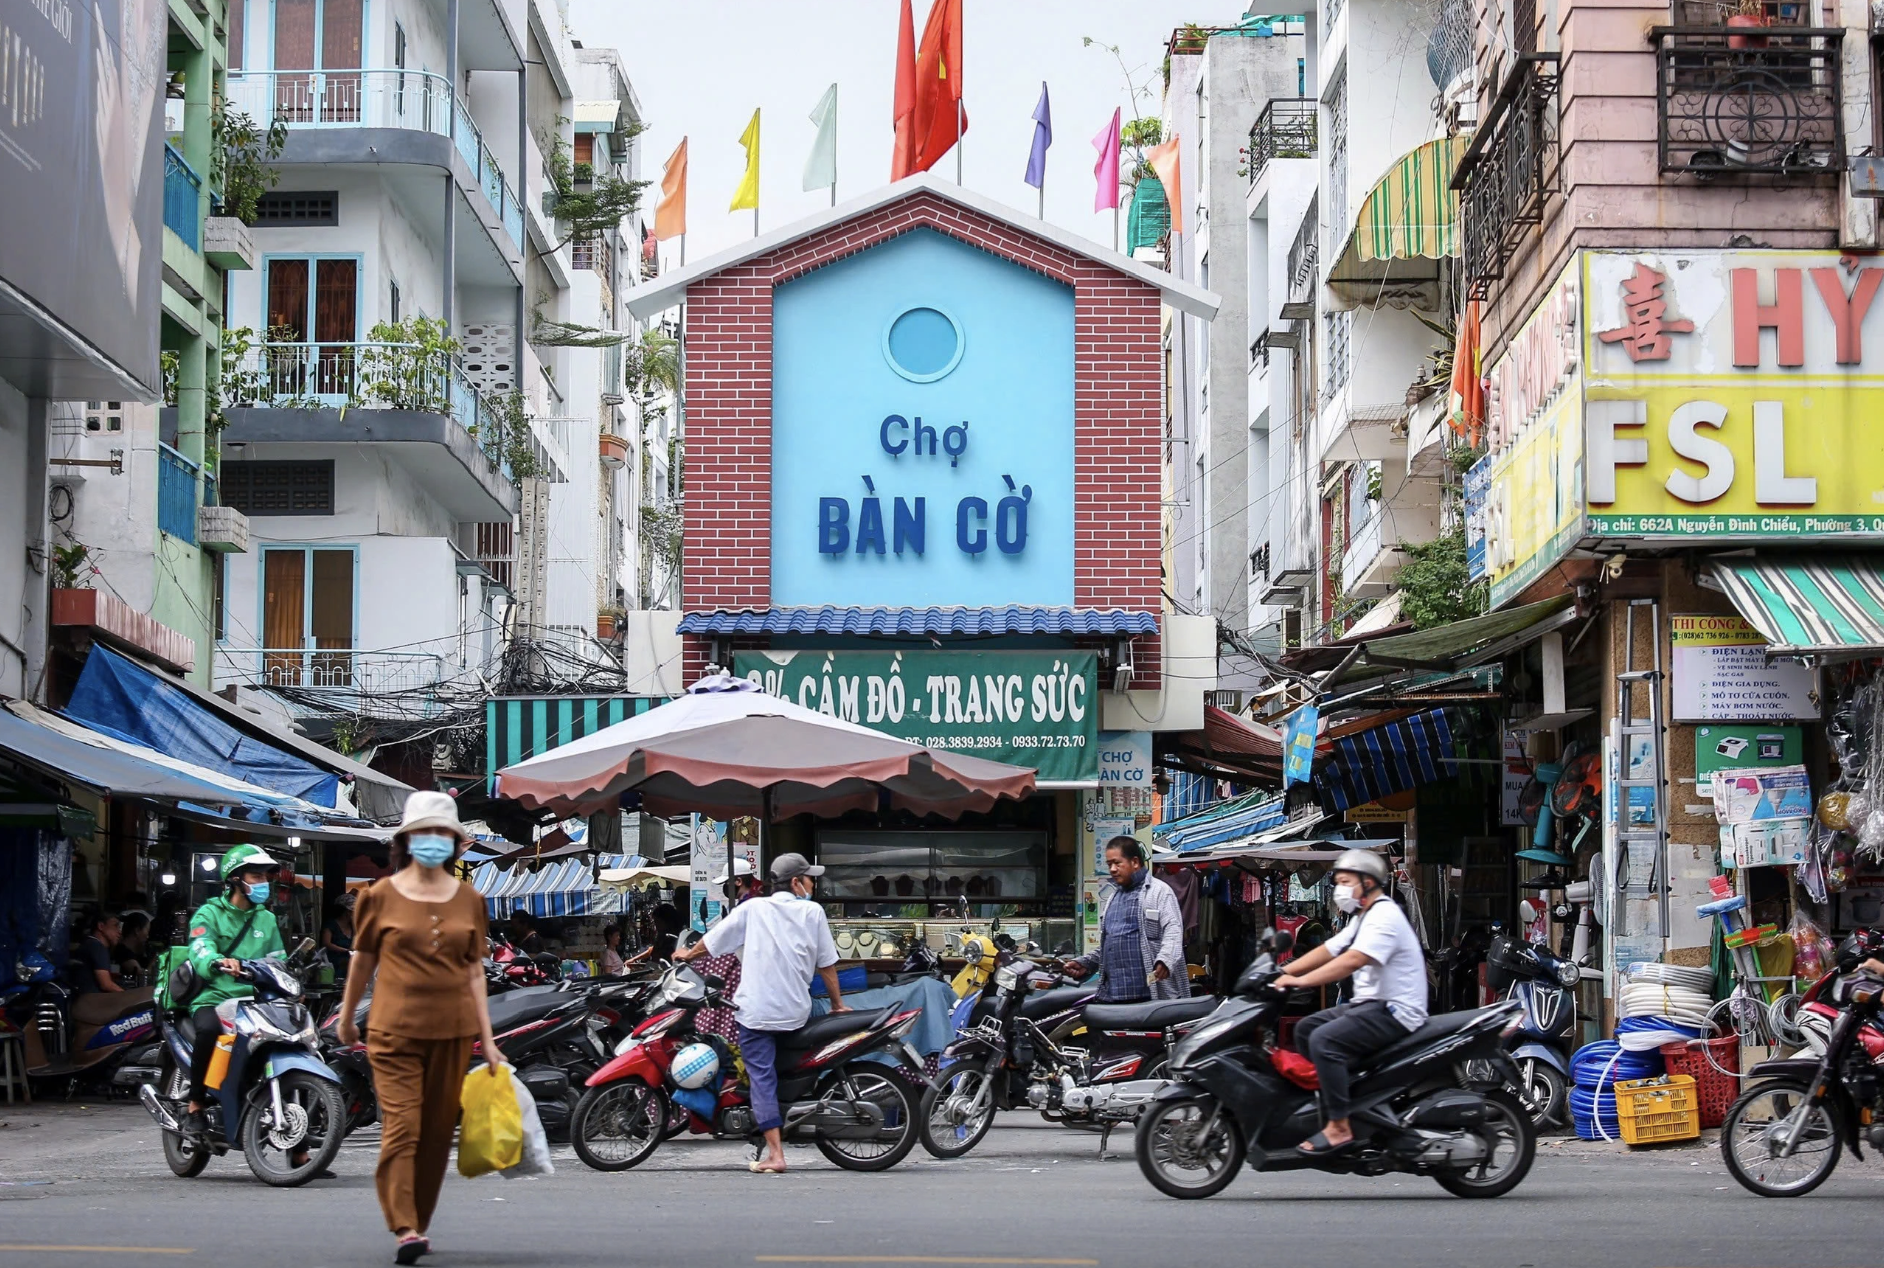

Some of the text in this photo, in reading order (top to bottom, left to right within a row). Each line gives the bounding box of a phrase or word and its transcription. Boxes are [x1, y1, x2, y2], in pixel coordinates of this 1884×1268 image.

[1599, 262, 1695, 363] 喜
[880, 414, 969, 468] Chợ
[1587, 400, 1817, 505] FSL
[818, 474, 1033, 555] BÀN CỜ
[1613, 518, 1635, 531] chỉ:
[1639, 518, 1673, 531] 662A
[1678, 516, 1724, 533] Nguyễn
[1728, 517, 1757, 531] Đình
[1761, 516, 1801, 533] Chiểu,
[1805, 517, 1852, 532] Phường
[1856, 518, 1869, 533] 3,
[1674, 618, 1695, 630] THI
[1699, 616, 1735, 630] CÔNG
[1706, 631, 1717, 640] 736
[1712, 648, 1738, 657] ĐIỆN
[799, 651, 860, 724] CẦM
[867, 651, 906, 724] ĐỒ
[926, 675, 1025, 724] TRANG
[1031, 659, 1086, 723] SỨC
[1712, 680, 1733, 688] ĐIỆN
[1711, 691, 1726, 699] MÔ
[926, 736, 1003, 749] 028.3839.2934
[1012, 735, 1086, 748] 0933.72.73.70
[1102, 750, 1133, 766] CHỢ
[1098, 767, 1144, 781] ÀN CỜ
[1505, 781, 1523, 791] MUA
[223, 858, 237, 872] Grab
[109, 1012, 153, 1036] Red Bull
